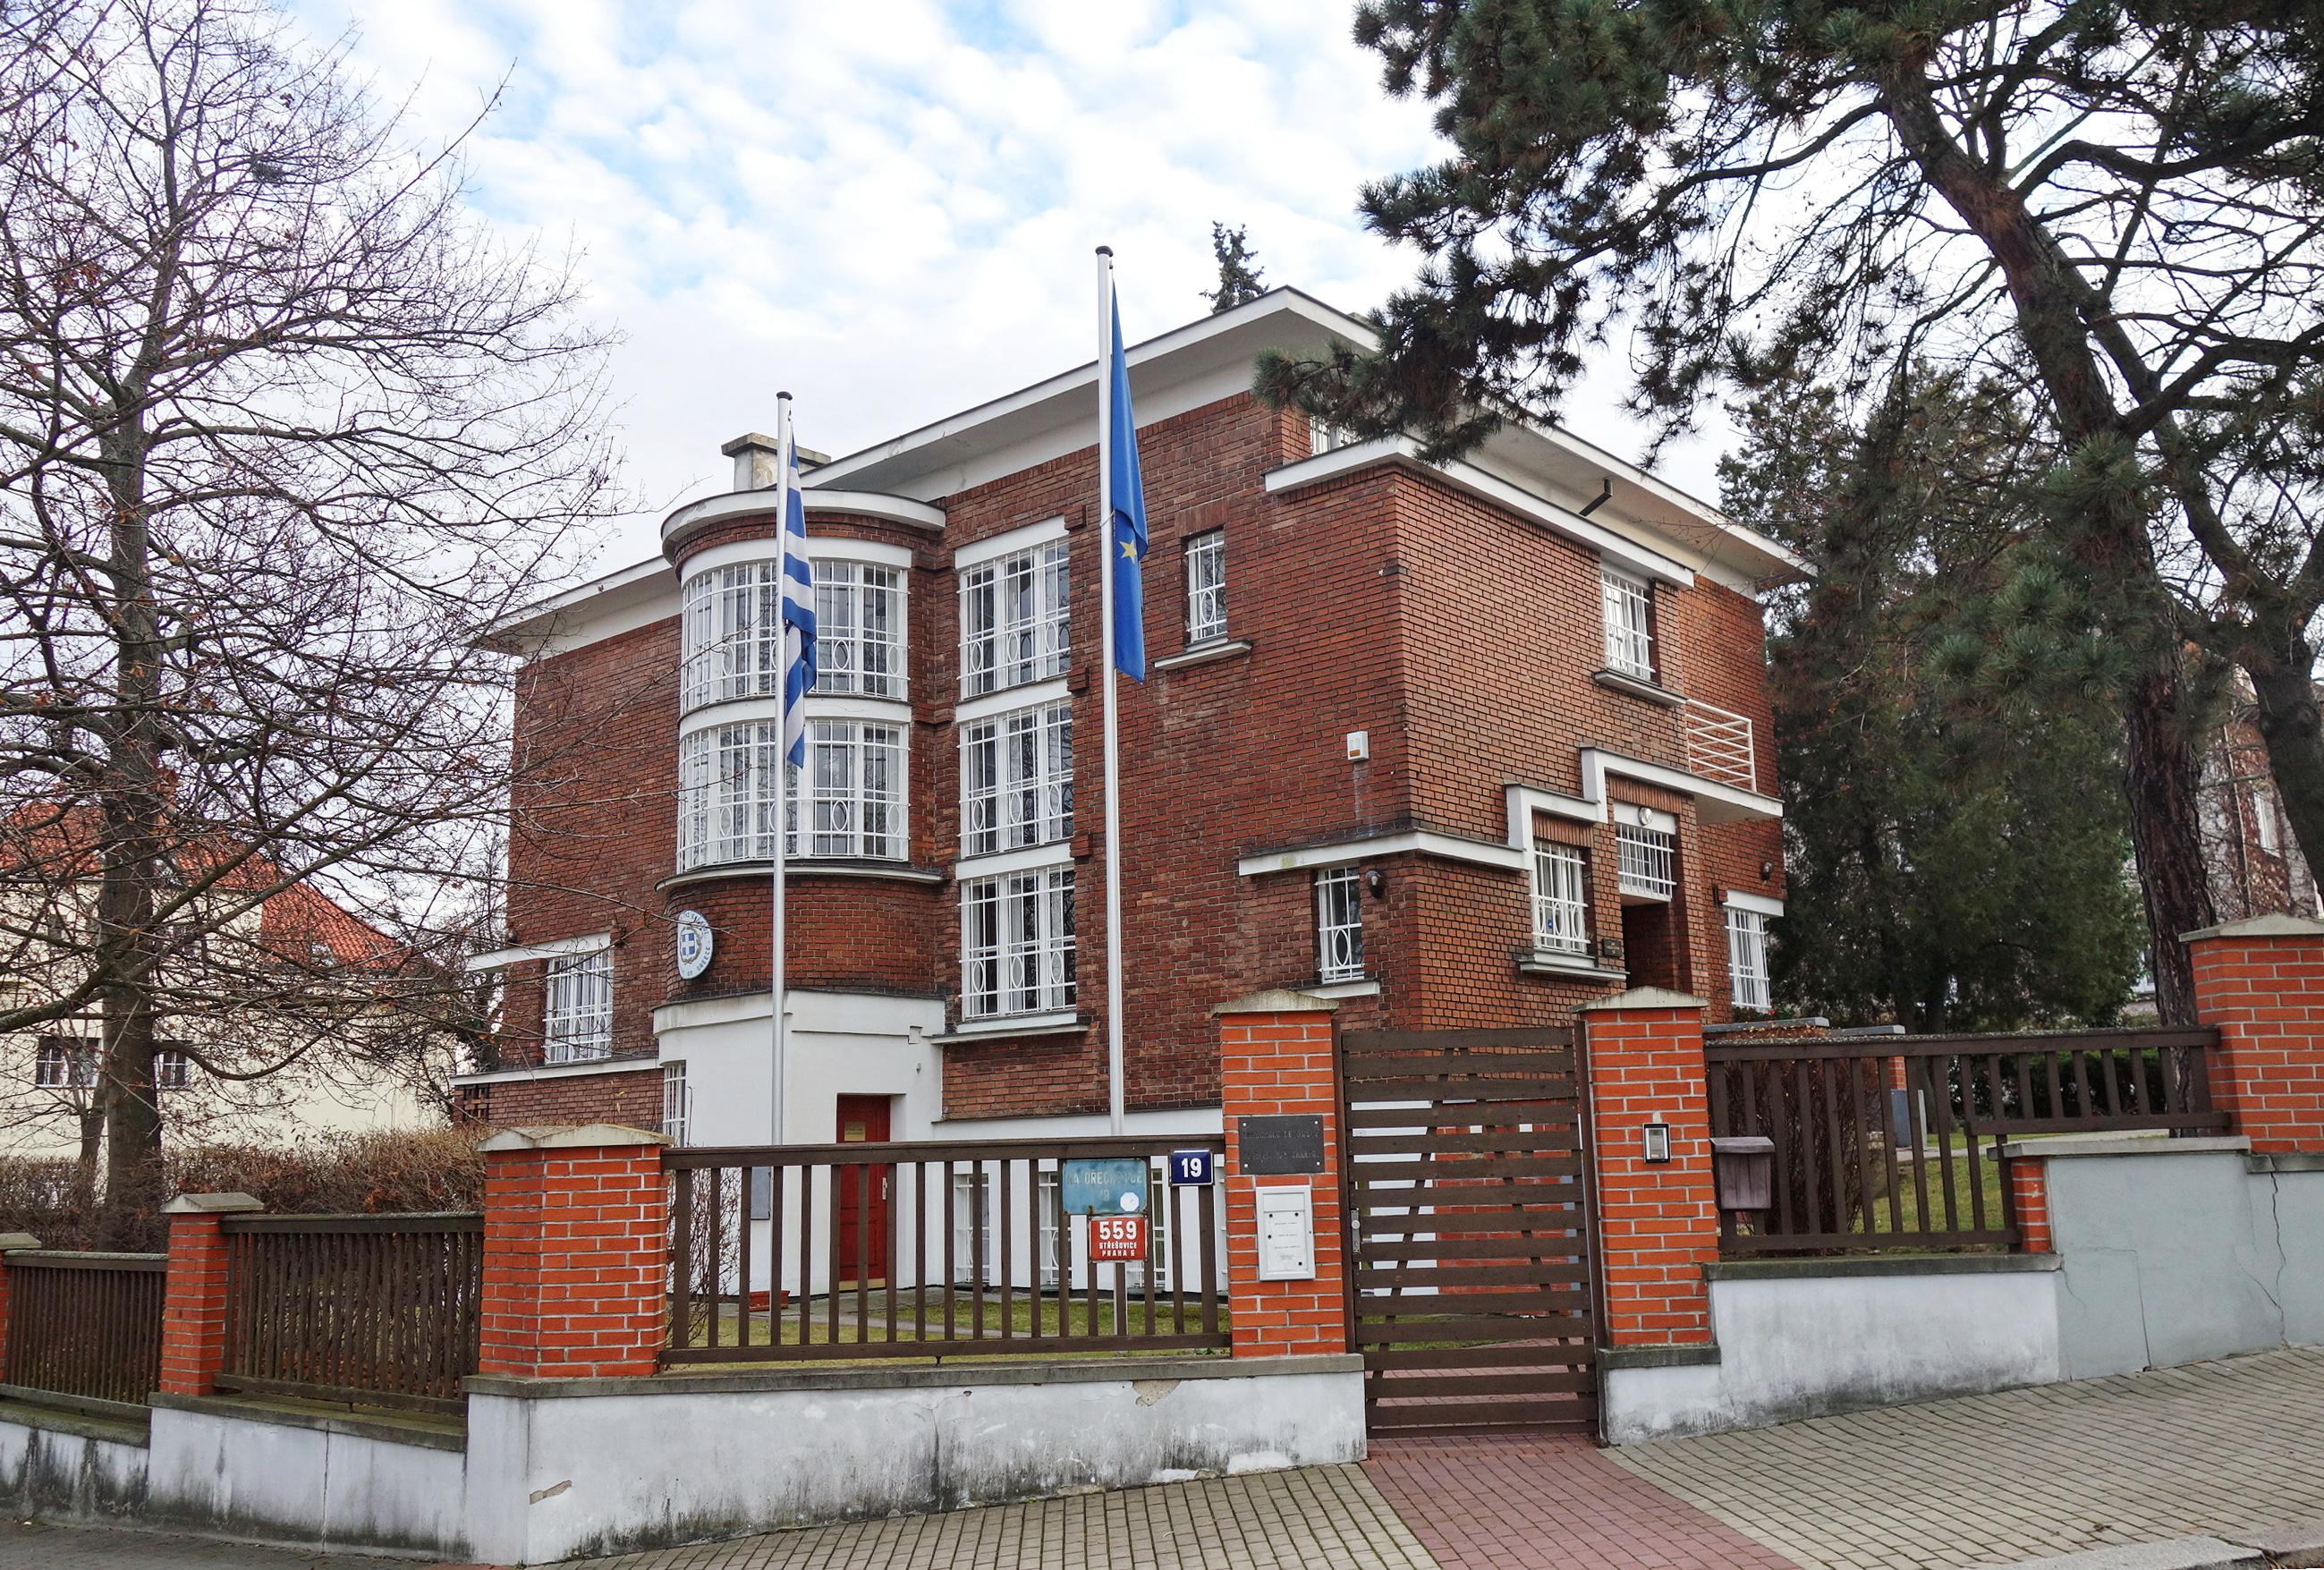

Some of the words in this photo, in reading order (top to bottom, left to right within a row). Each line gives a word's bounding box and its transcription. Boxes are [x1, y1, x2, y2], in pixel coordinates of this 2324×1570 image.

[696, 946, 711, 972] GREECE
[1181, 1157, 1202, 1178] 19
[1099, 1220, 1137, 1240] 559
[1098, 1240, 1137, 1250] STŘEŠOVICE
[1101, 1249, 1127, 1257] PRAHA
